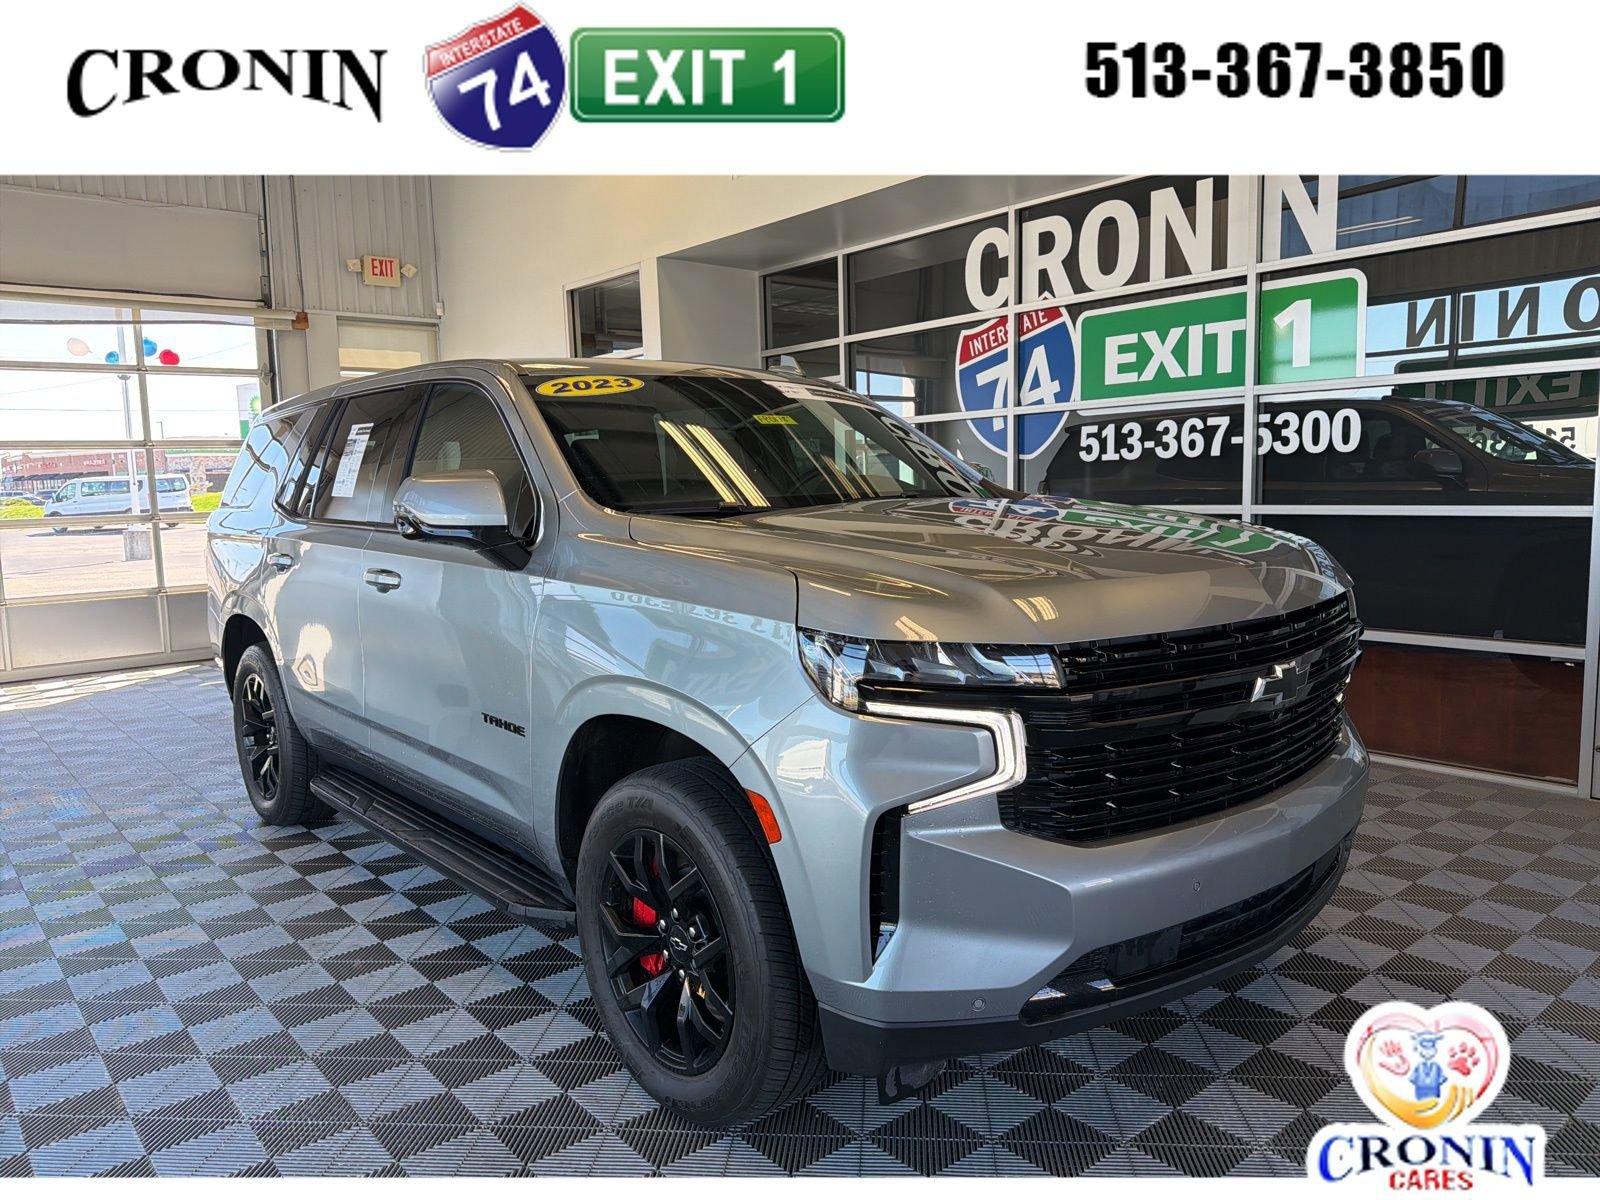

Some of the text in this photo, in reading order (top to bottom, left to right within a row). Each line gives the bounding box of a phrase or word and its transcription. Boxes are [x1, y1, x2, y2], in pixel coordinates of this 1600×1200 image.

[965, 174, 1339, 313] CRONIN
[371, 257, 394, 278] EXIT
[968, 310, 1048, 357] INTERATE
[1104, 298, 1312, 386] EXIT 1
[551, 378, 635, 394] 2023
[976, 344, 1061, 432] 74
[481, 712, 526, 738] TAHOE
